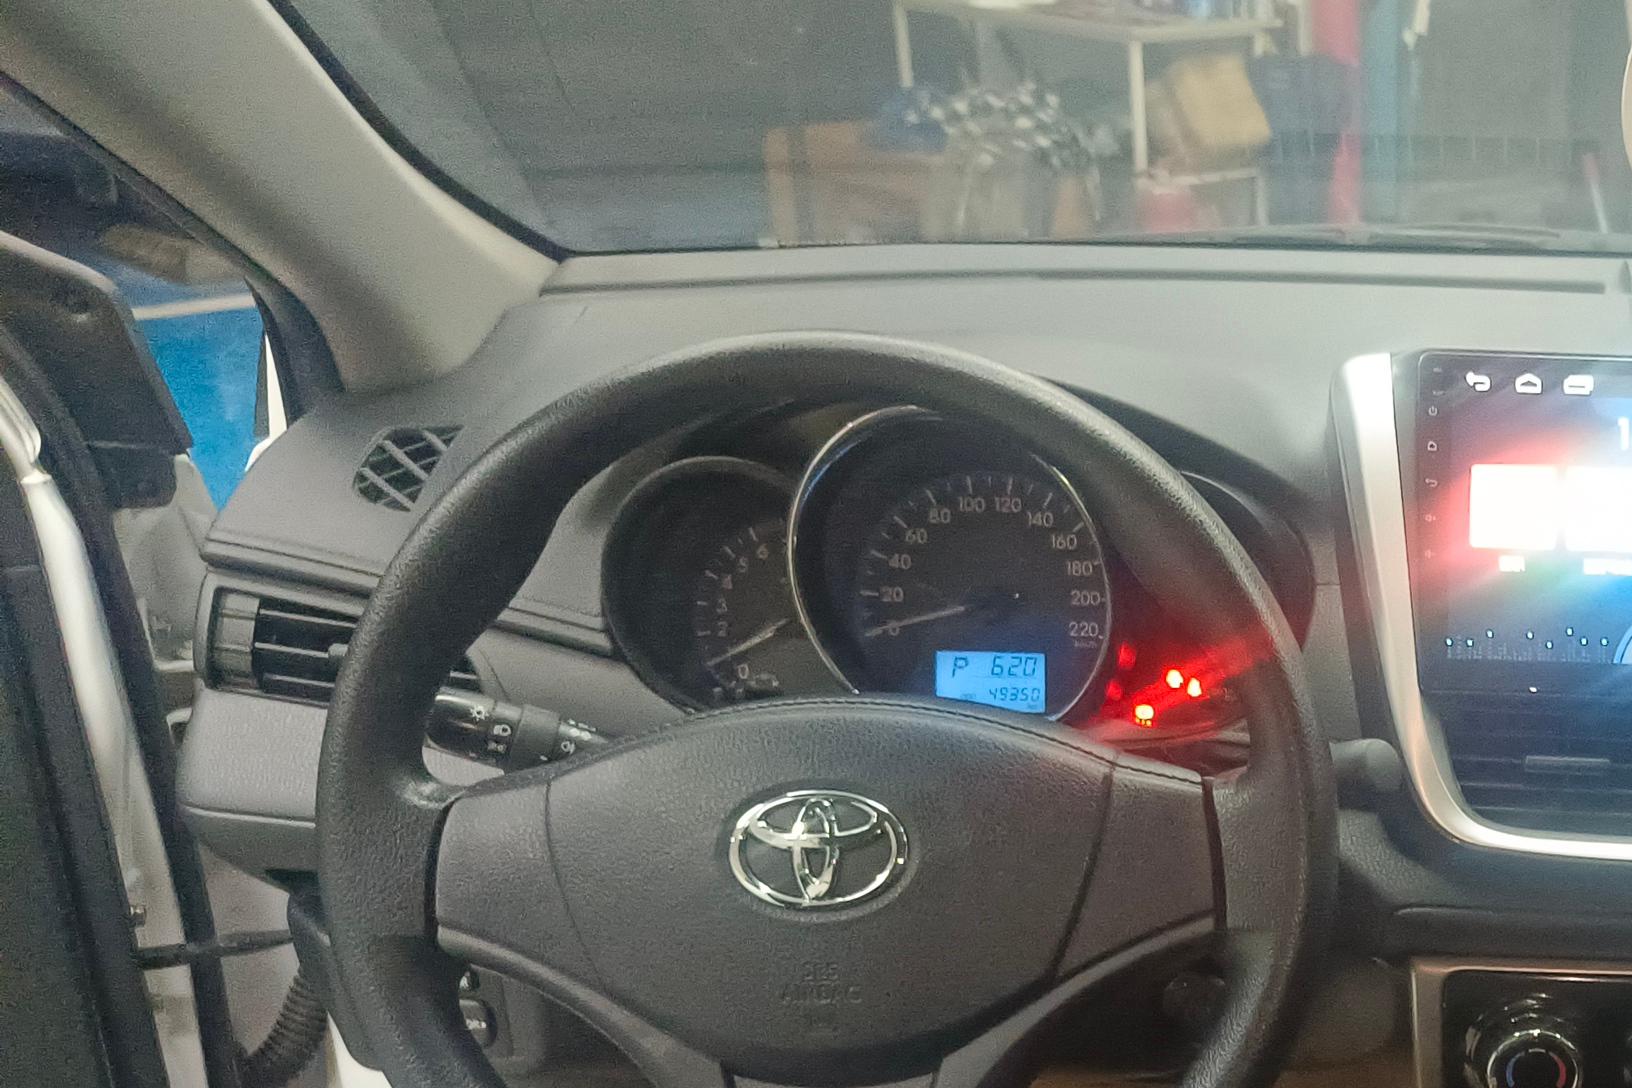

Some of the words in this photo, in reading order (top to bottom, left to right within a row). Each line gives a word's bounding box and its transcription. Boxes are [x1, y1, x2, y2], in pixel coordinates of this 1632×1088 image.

[958, 496, 985, 512] 100
[994, 496, 1022, 512] 120
[929, 507, 950, 524] 80
[1027, 511, 1054, 527] 140
[905, 528, 928, 544] 60
[1052, 534, 1077, 550] 160
[888, 553, 912, 570] 40
[1066, 560, 1093, 576] 180
[880, 586, 904, 602] 20
[1071, 590, 1100, 606] 200
[1069, 621, 1099, 637] 220
[952, 655, 969, 678] P
[991, 655, 1038, 677] 620
[988, 687, 1041, 702] 49350
